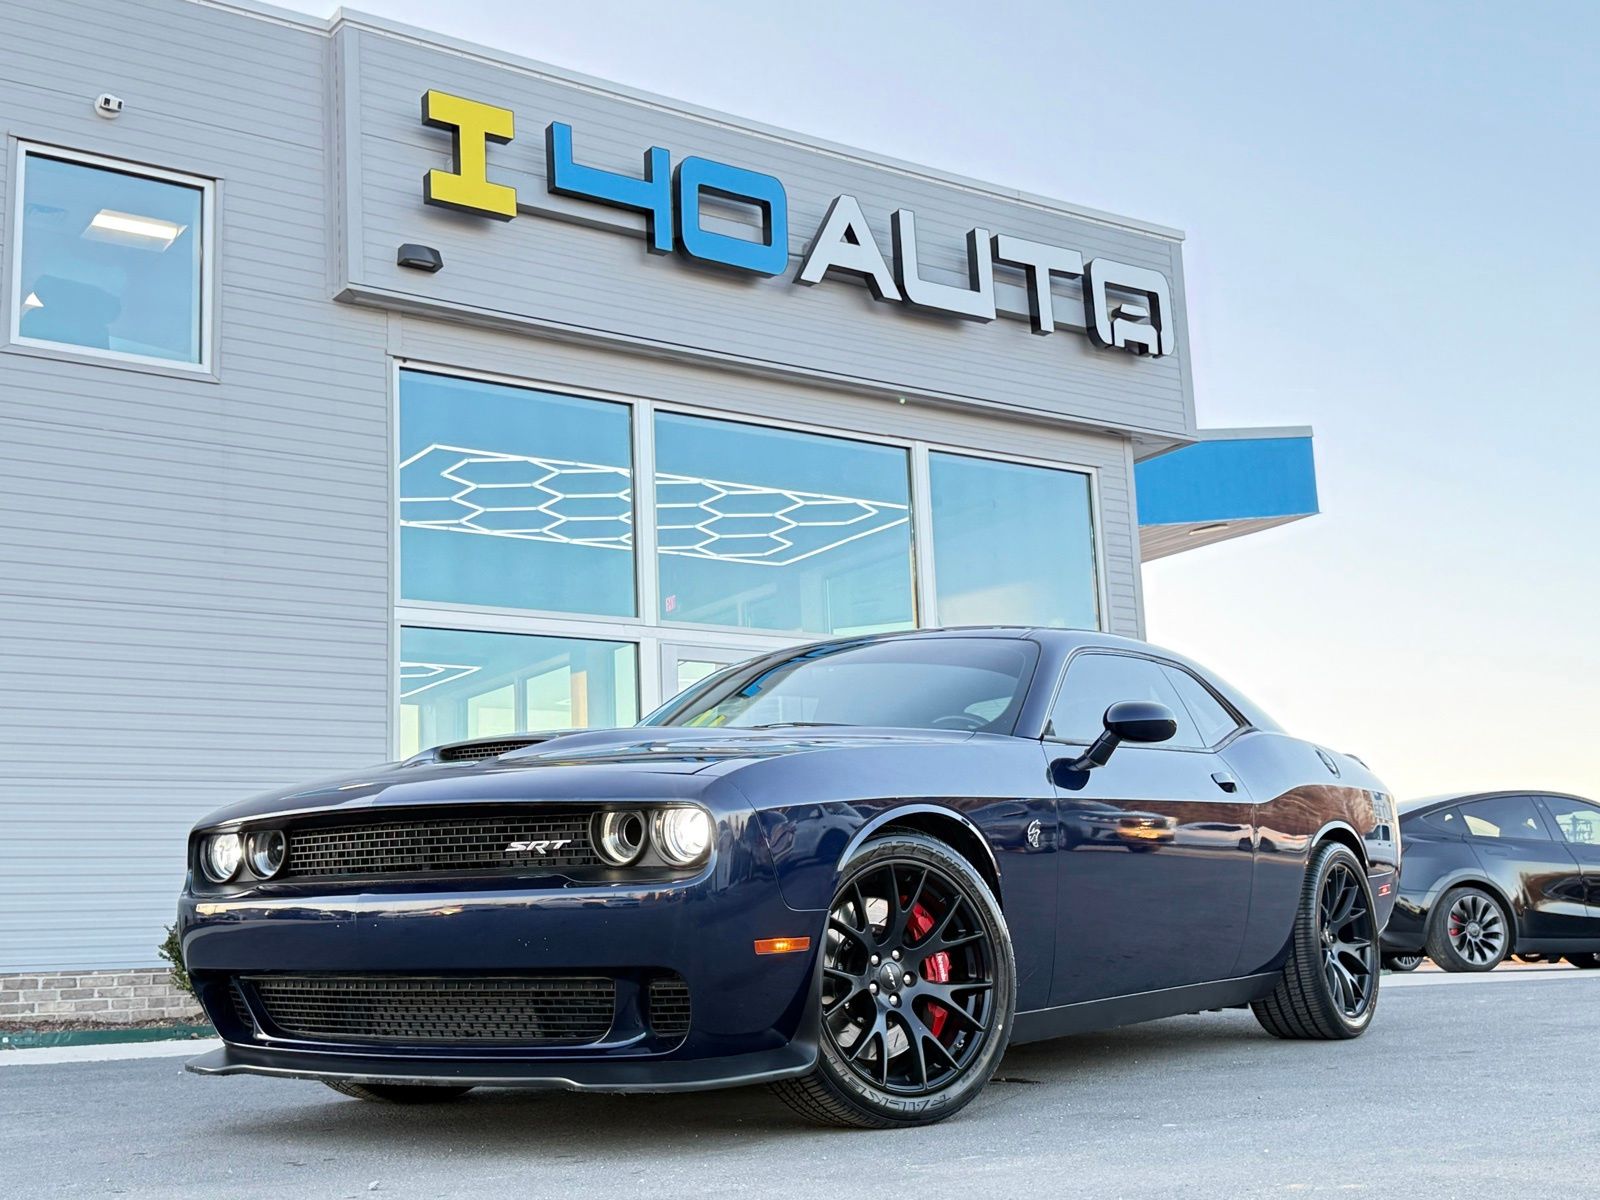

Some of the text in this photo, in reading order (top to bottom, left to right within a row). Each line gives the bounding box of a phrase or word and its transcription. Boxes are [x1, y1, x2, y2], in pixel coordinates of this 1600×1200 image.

[421, 89, 518, 221] I
[546, 121, 789, 278] 40
[505, 839, 572, 855] SRT
